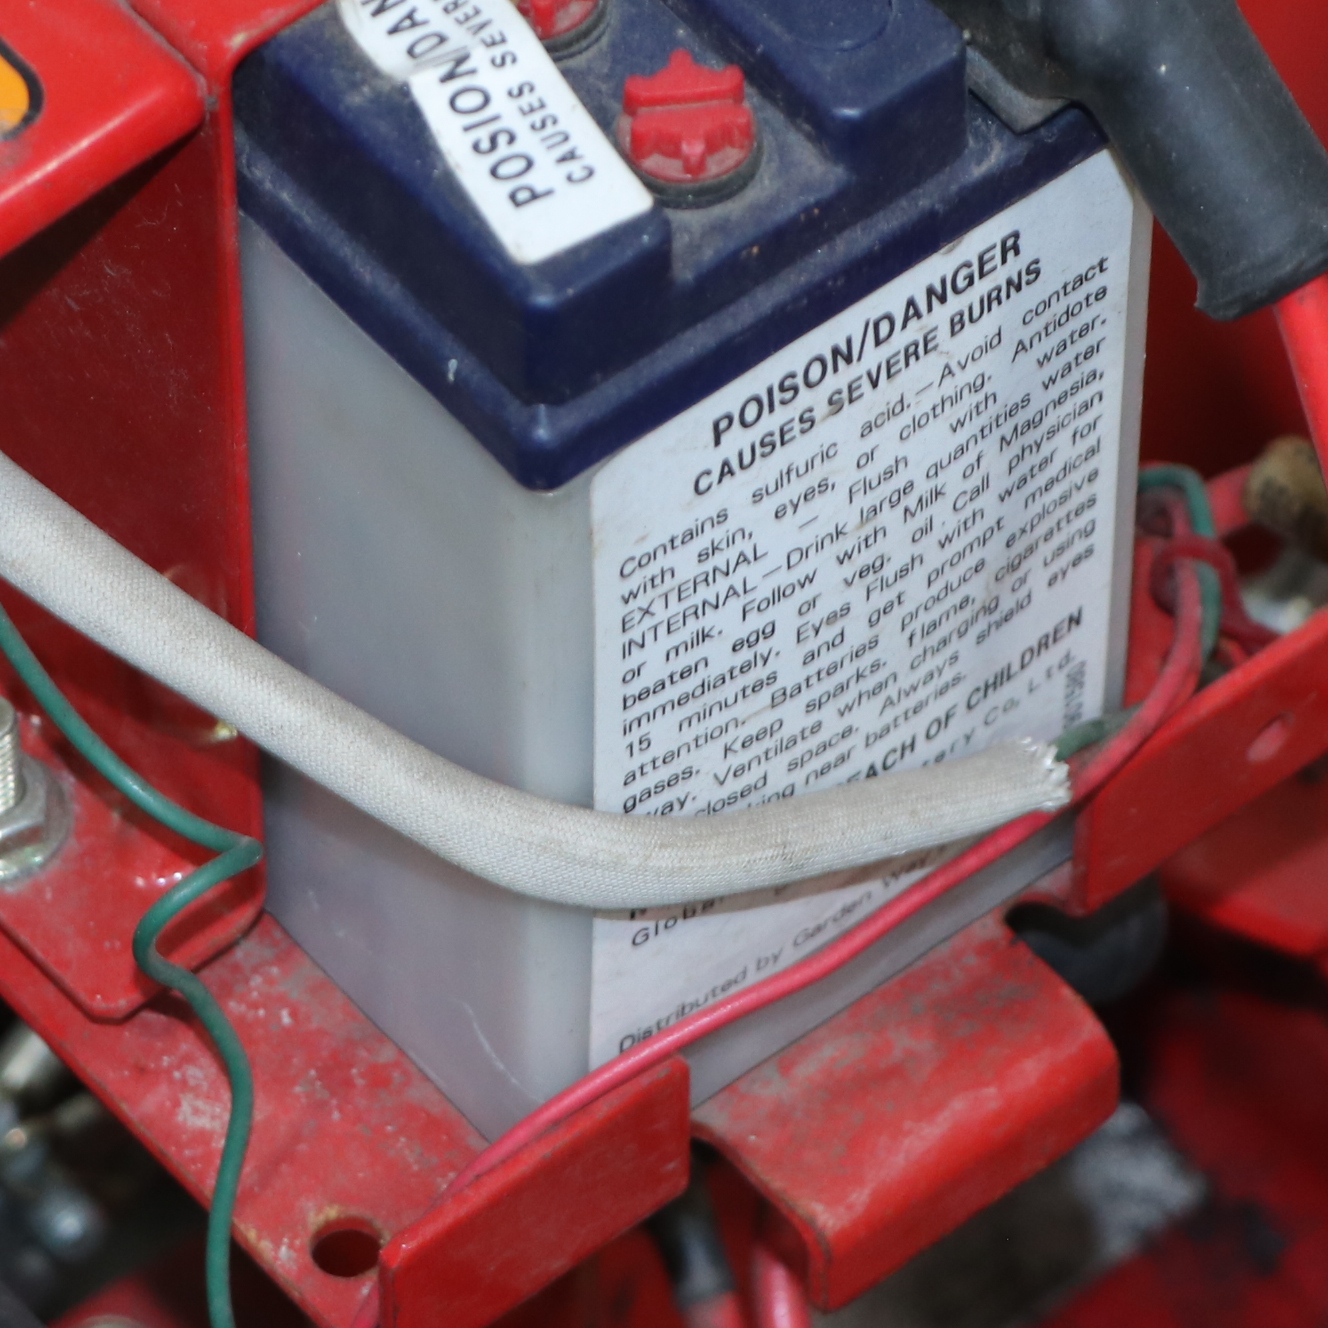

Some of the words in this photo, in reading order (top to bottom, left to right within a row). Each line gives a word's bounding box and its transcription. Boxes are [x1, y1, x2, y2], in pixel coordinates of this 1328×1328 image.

[507, 79, 596, 184] CAUSES
[618, 507, 729, 580] Contains
[750, 441, 838, 505] sulfuric
[1021, 255, 1109, 326] contact
[619, 565, 675, 605] with
[696, 526, 753, 564] skin,
[773, 476, 836, 520] eyes,
[855, 443, 879, 470] or
[898, 370, 992, 442] clothing.
[1010, 284, 1108, 364] Antidote
[620, 541, 769, 634] EXTERNAL
[847, 454, 908, 506] Flush
[948, 390, 997, 434] with
[1035, 313, 1107, 369] water.
[693, 406, 817, 496] CAUSES
[827, 329, 939, 414] SEVERE
[949, 258, 1043, 337] BURNS
[712, 230, 1021, 448] POISON/DANGER
[859, 479, 914, 530] large
[924, 391, 1031, 480] quantities
[1040, 335, 1106, 391] water
[620, 660, 647, 685] or
[664, 624, 723, 664] milk.
[741, 566, 818, 623] Follow
[834, 525, 887, 566] with
[902, 481, 947, 525] Milk
[961, 448, 984, 480] of
[998, 367, 1105, 453] Magnesia,
[621, 655, 709, 712] beaten
[730, 618, 776, 653] egg
[797, 592, 822, 617] or
[841, 552, 892, 588] veg.
[951, 470, 990, 513] Call
[1007, 389, 1103, 477] physician
[622, 645, 781, 737] immediately.
[795, 601, 851, 645] Eyes
[865, 552, 924, 604] Flush
[936, 507, 985, 550] with
[997, 446, 1058, 503] water
[1070, 413, 1103, 447] for
[622, 715, 749, 787] attention.
[769, 633, 879, 710] Batteries
[899, 556, 985, 633] produce
[1004, 467, 1099, 549] explosive
[622, 764, 701, 815] gases.
[723, 717, 784, 761] Keep
[907, 594, 976, 649] flame,
[993, 492, 1097, 583] cigarettes
[624, 730, 652, 759] 15
[677, 669, 778, 733] minutes
[801, 625, 845, 667] and
[867, 589, 905, 629] get
[926, 515, 1004, 590] prompt
[1023, 434, 1101, 511] medical
[712, 719, 823, 787] Ventilate
[836, 670, 898, 718] when
[909, 594, 999, 671] charging
[1010, 567, 1032, 594] or
[1042, 517, 1096, 568] using
[786, 724, 860, 773] space.
[877, 649, 959, 717] Always
[975, 587, 1032, 645] shield
[1046, 543, 1094, 588] eyes
[924, 702, 958, 741] OF
[965, 605, 1082, 712] CHILDREN
[803, 744, 856, 787] near
[863, 671, 966, 749] batteries.
[756, 947, 783, 972] by
[793, 891, 872, 948] Garden
